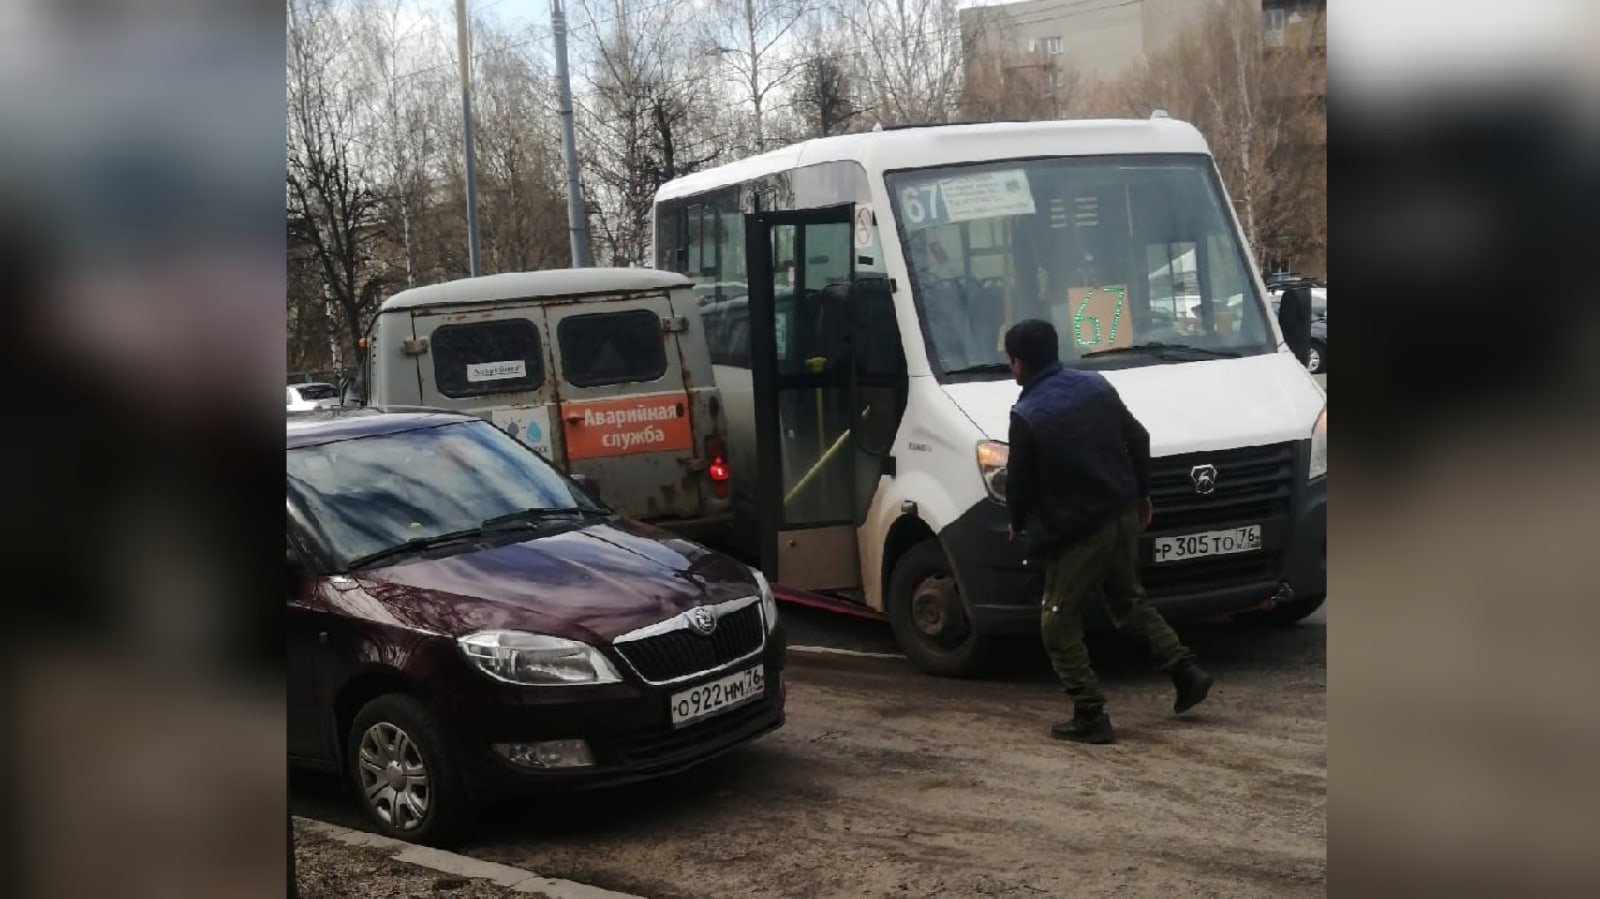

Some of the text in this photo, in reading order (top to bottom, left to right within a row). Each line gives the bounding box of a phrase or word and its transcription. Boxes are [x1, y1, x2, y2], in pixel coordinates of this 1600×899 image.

[902, 184, 938, 223] 67
[1073, 287, 1124, 347] 67
[584, 404, 676, 427] Аварийная
[602, 426, 665, 449] служба
